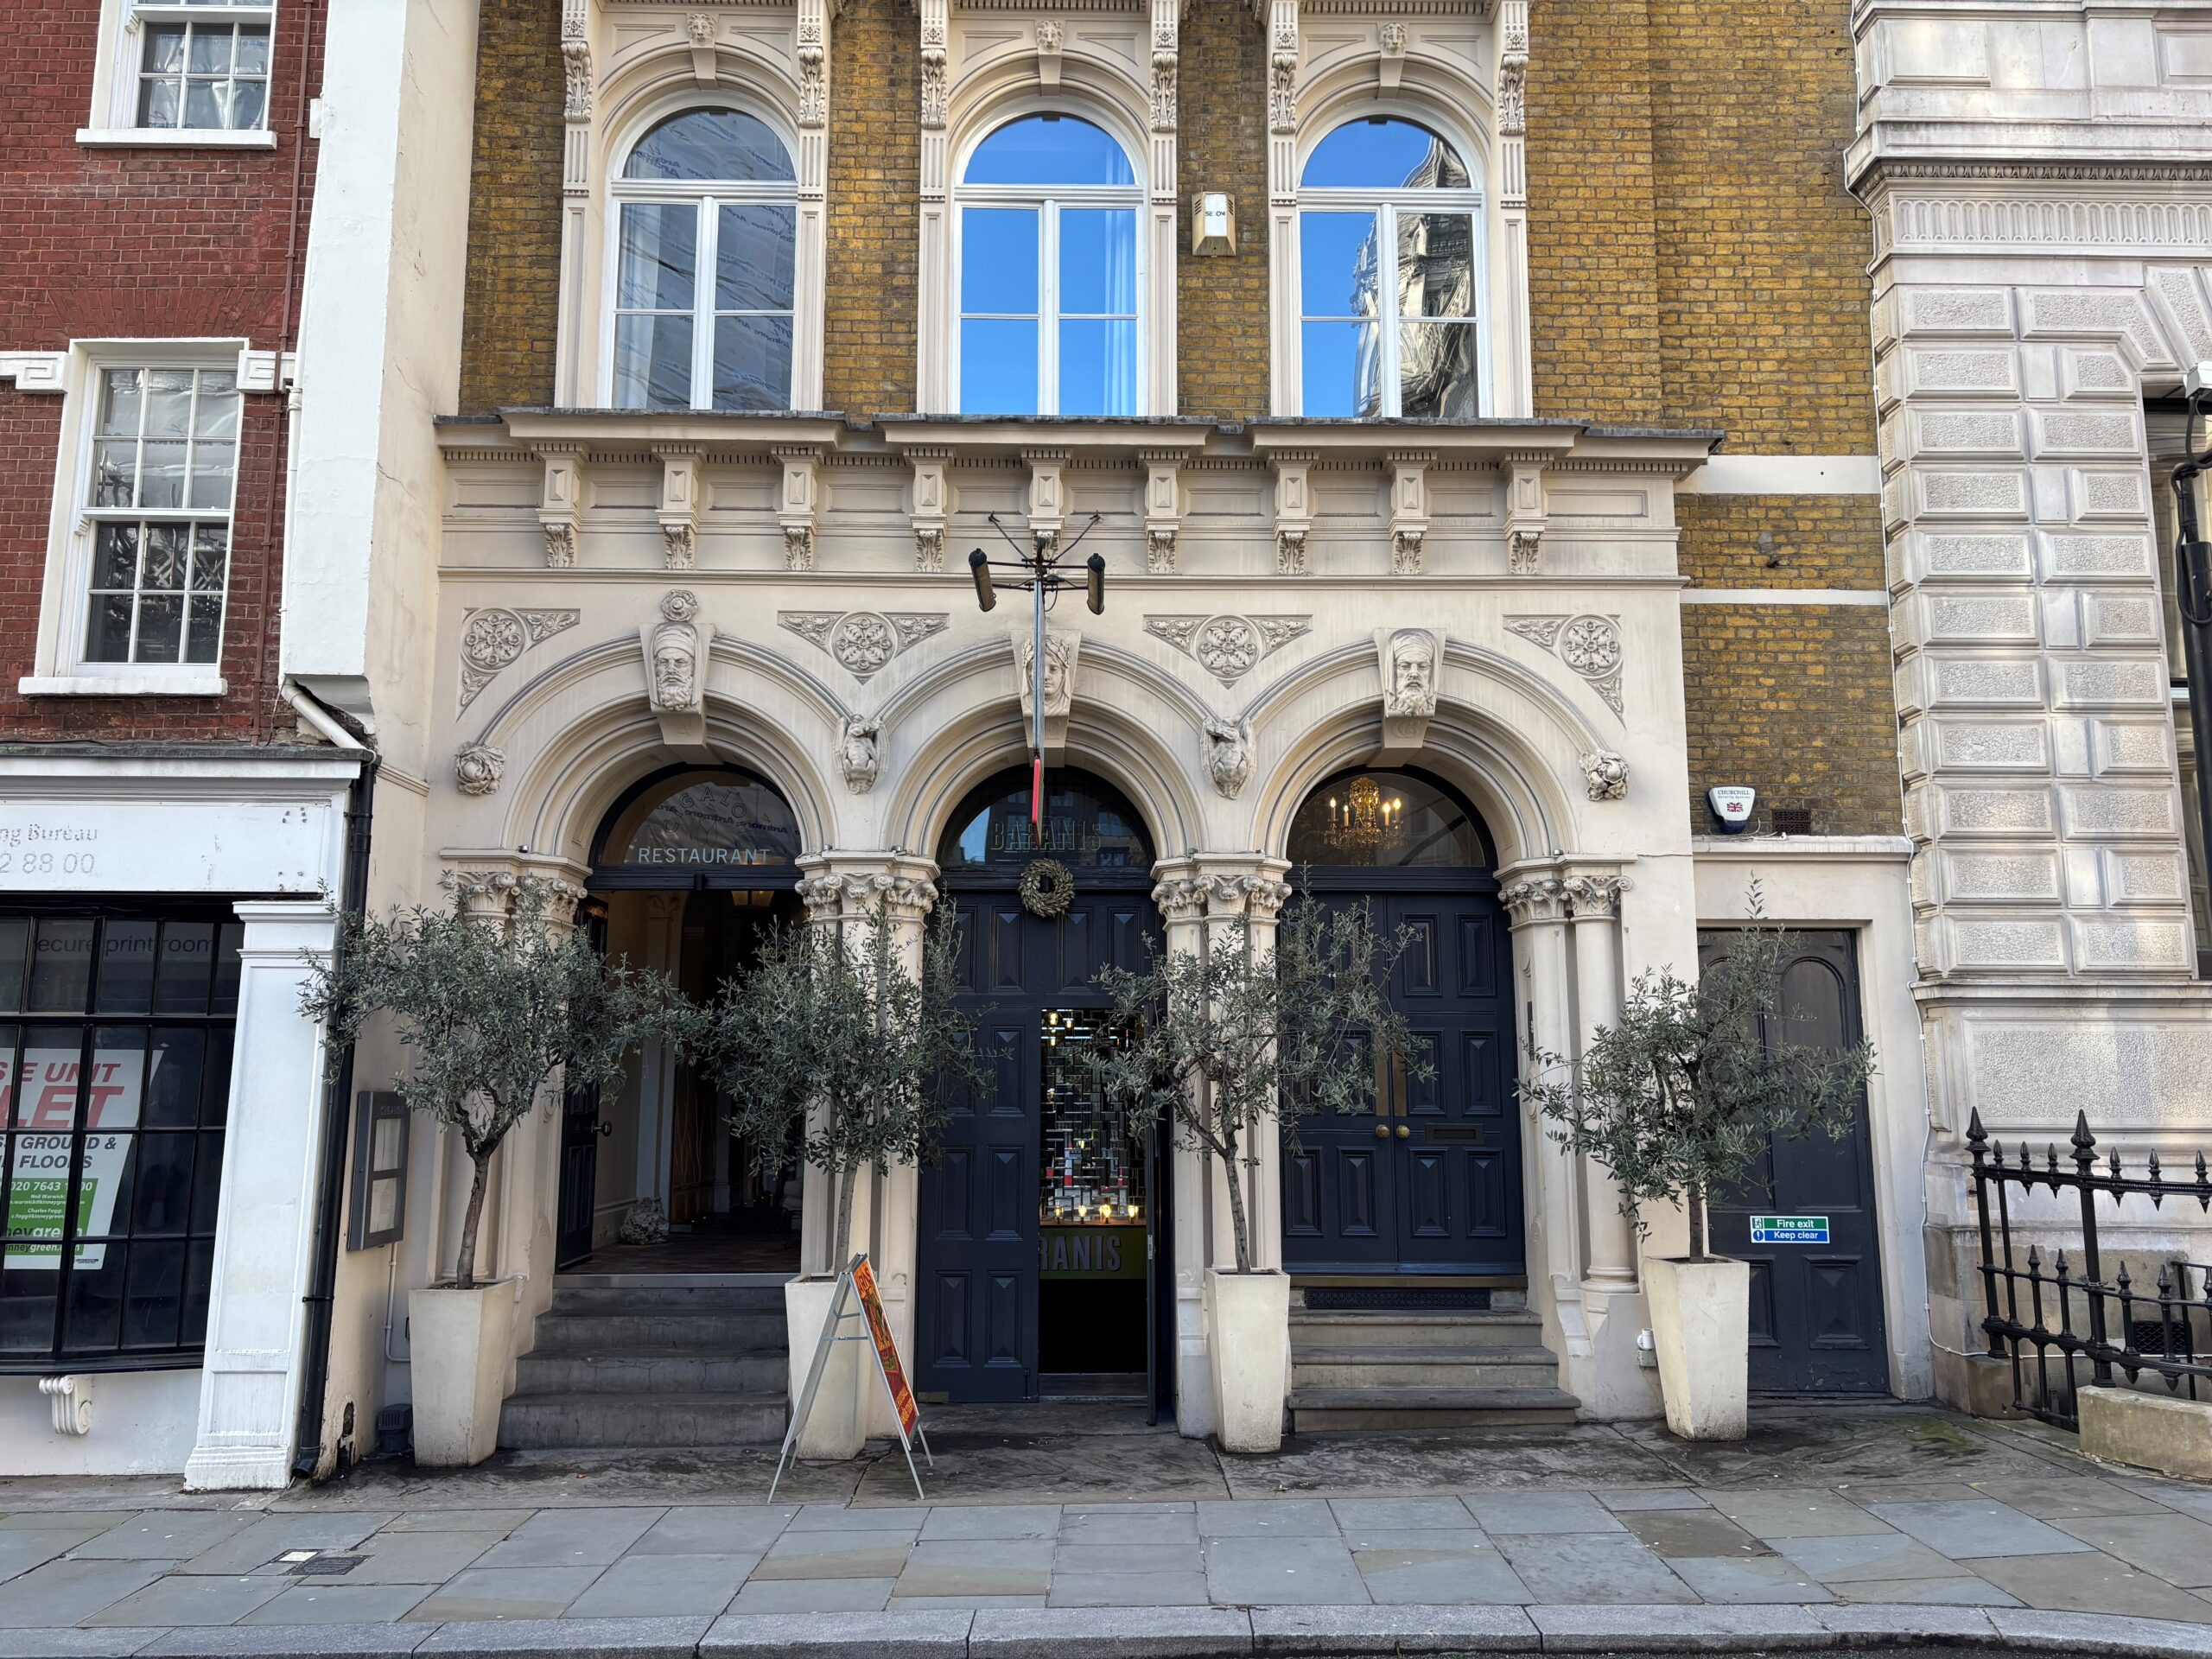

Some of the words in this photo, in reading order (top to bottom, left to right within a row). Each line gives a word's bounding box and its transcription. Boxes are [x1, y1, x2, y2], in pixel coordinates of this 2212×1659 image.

[638, 848, 771, 864] RESTAURANT
[21, 1136, 100, 1150] GROUD
[104, 1136, 118, 1150] &
[19, 1154, 93, 1169] FLOOS
[33, 1181, 61, 1192] 7643
[1776, 1219, 1796, 1228] Fire
[1796, 1219, 1815, 1229] exit
[1773, 1230, 1796, 1241] Keep
